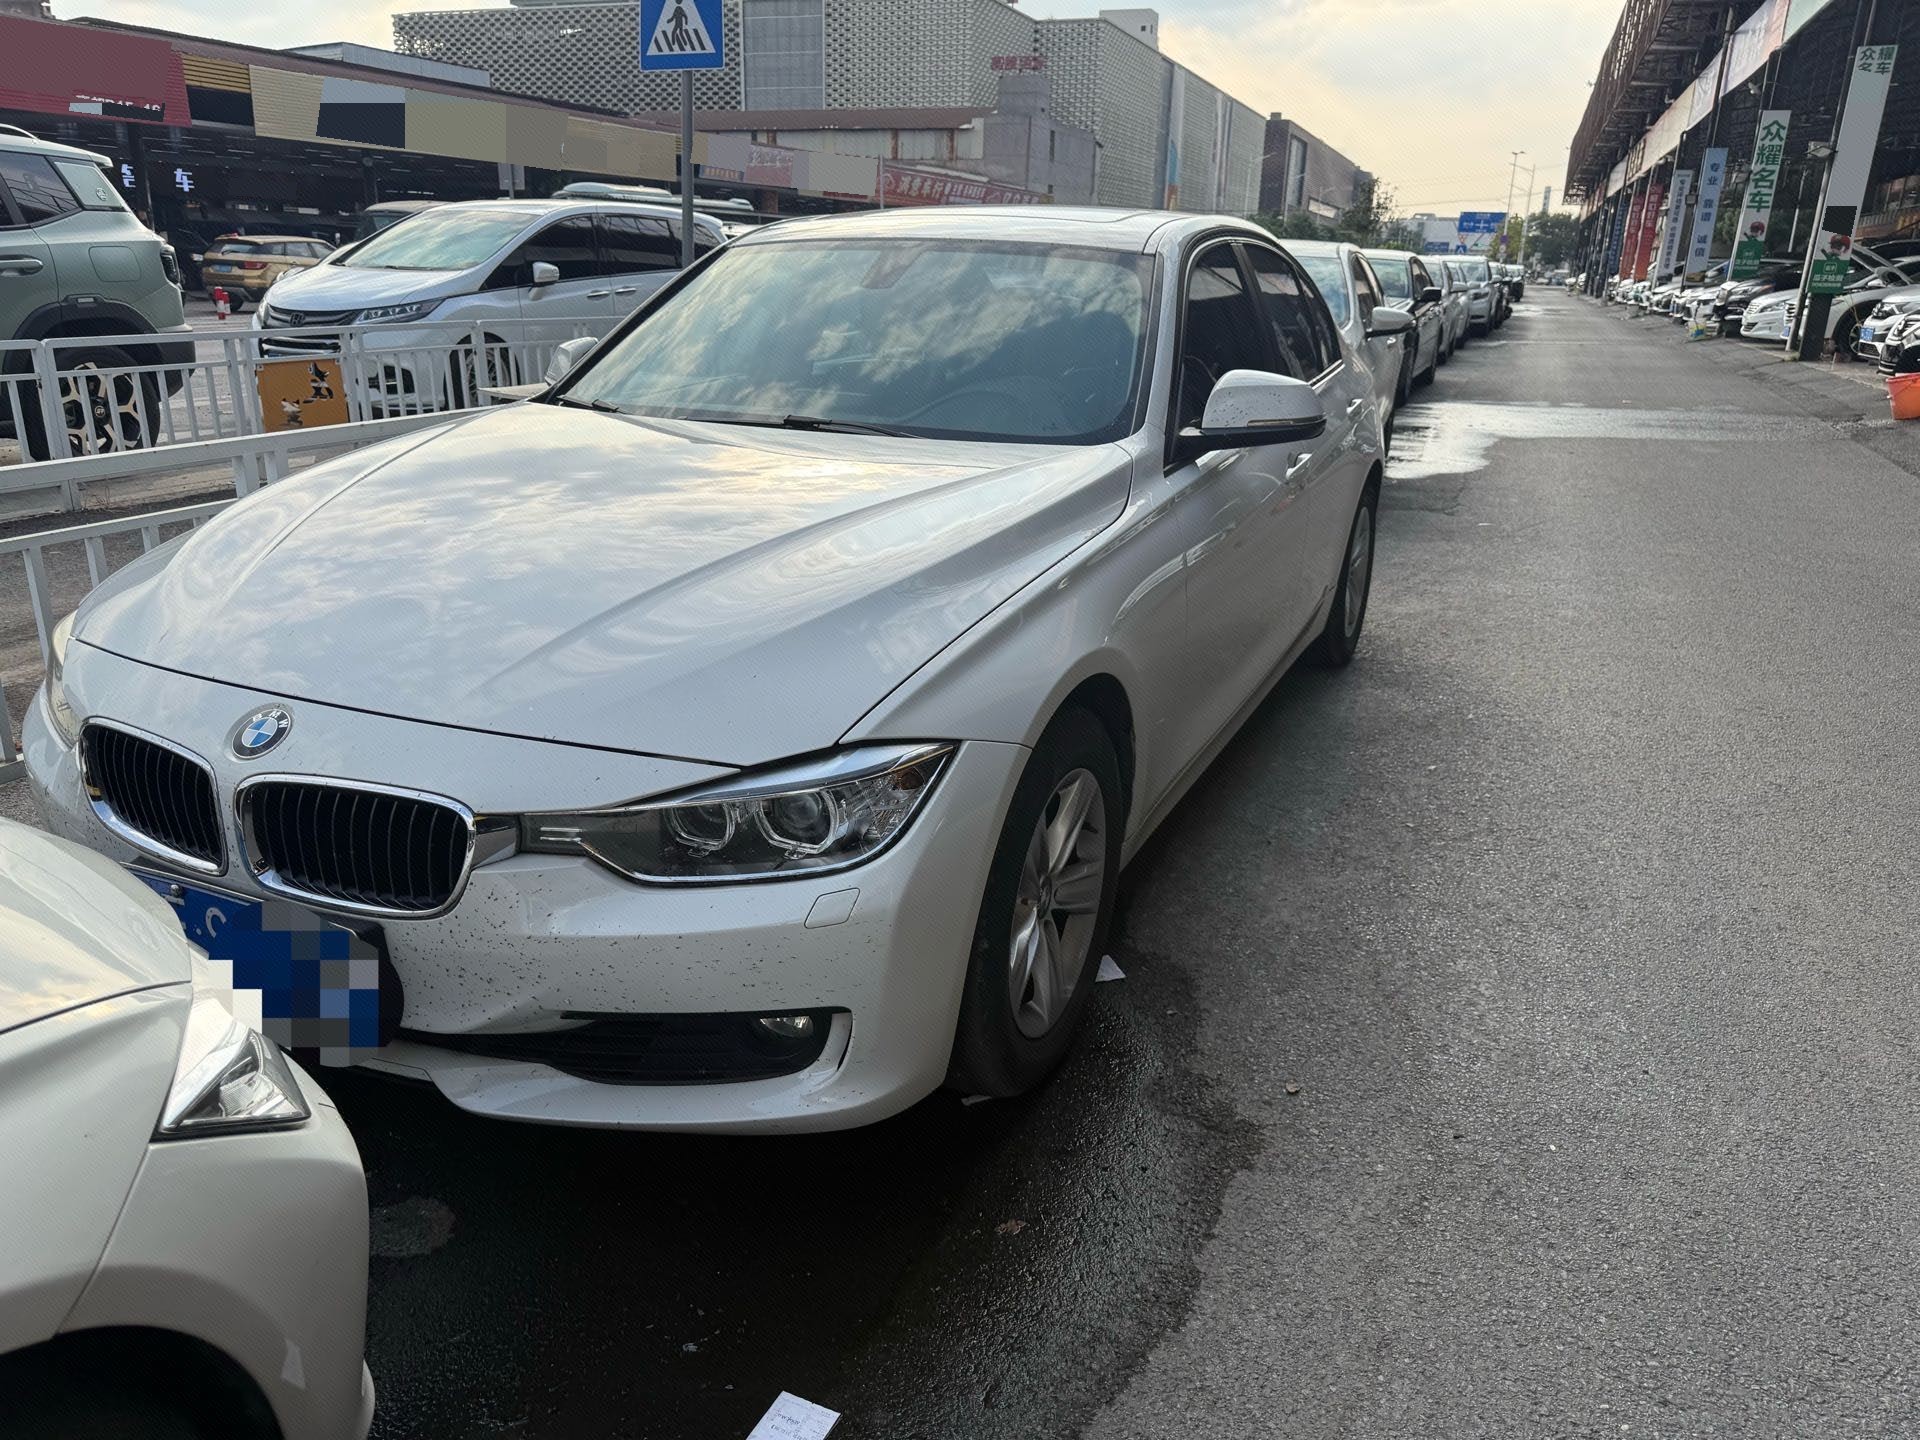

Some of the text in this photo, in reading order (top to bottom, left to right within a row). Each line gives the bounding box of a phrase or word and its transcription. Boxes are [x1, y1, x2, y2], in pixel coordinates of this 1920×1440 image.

[1707, 162, 1720, 186] 专业
[1746, 119, 1787, 213] 众耀名车
[252, 709, 289, 729] BMW
